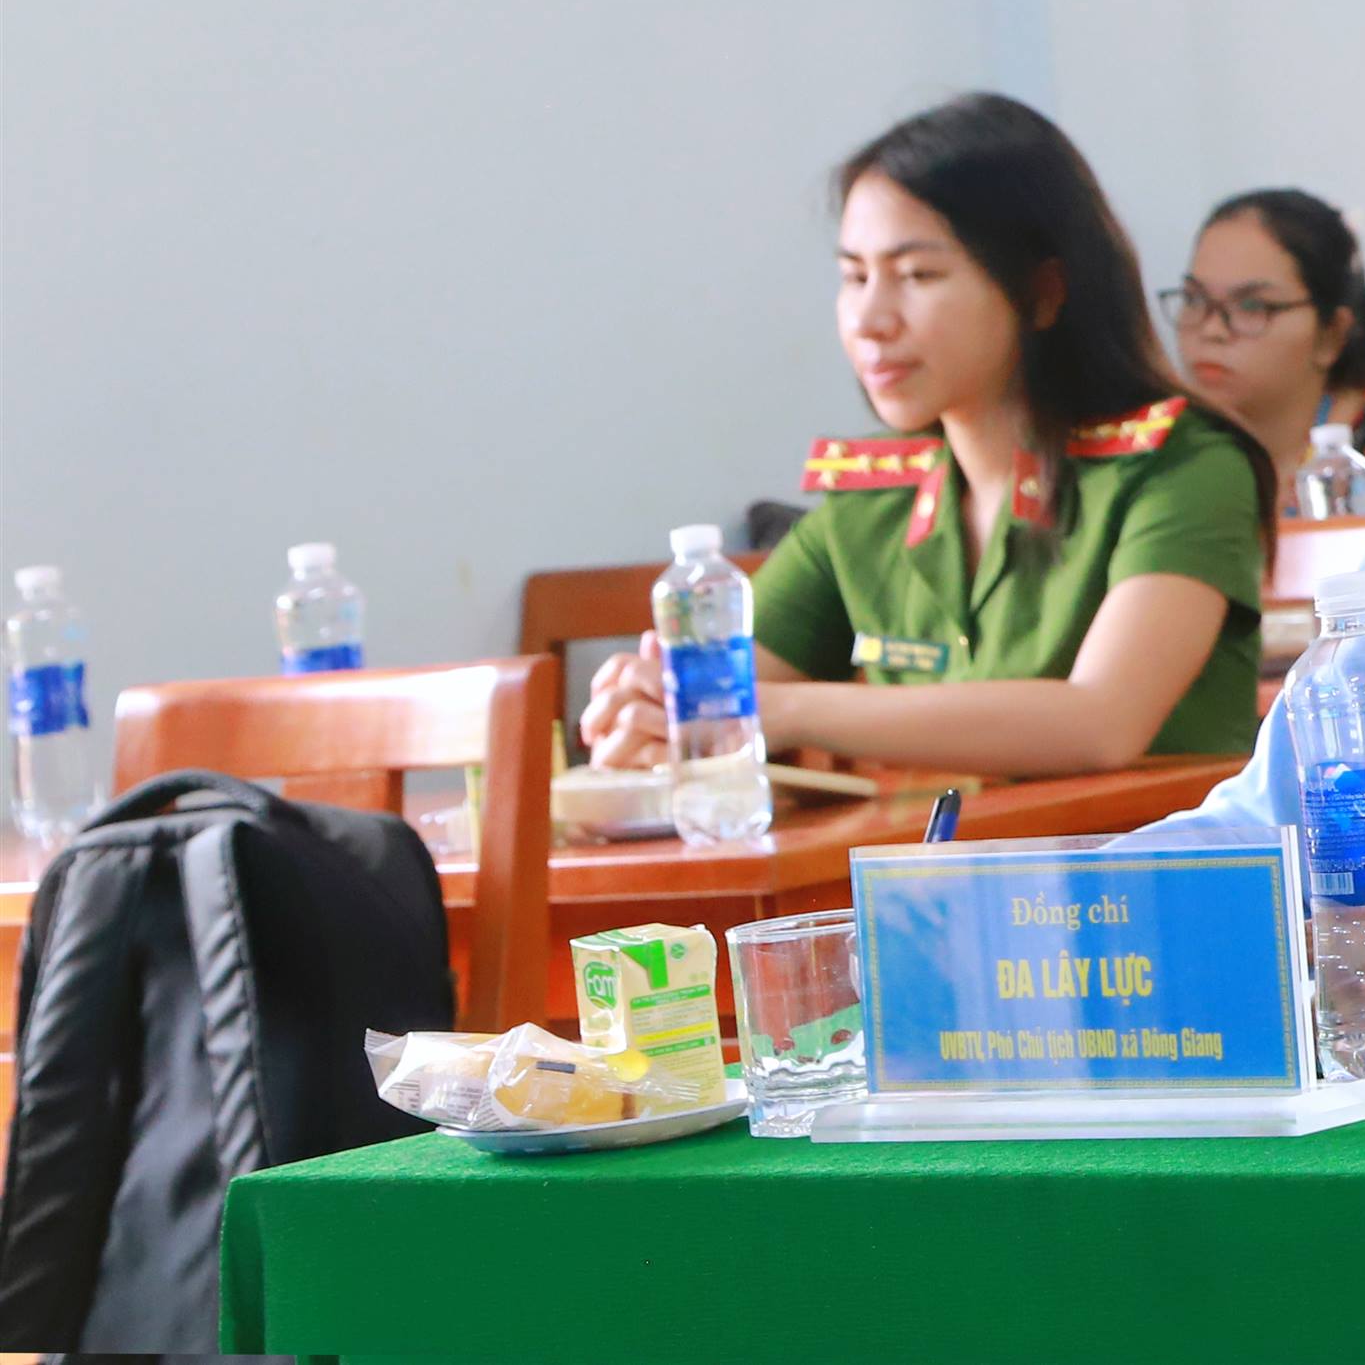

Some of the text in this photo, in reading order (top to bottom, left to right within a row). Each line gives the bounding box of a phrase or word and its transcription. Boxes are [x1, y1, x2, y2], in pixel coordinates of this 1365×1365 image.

[1011, 891, 1130, 931] Đồng chí
[1041, 949, 1091, 999] LÂY
[1099, 953, 1153, 1006] LỰC
[987, 1029, 1014, 1059] Phó
[1018, 1026, 1044, 1059] Chủ
[1047, 1028, 1075, 1066] tịch
[1077, 1028, 1116, 1058] UBND
[1120, 1028, 1138, 1059] xã
[1181, 1026, 1223, 1060] Giang
